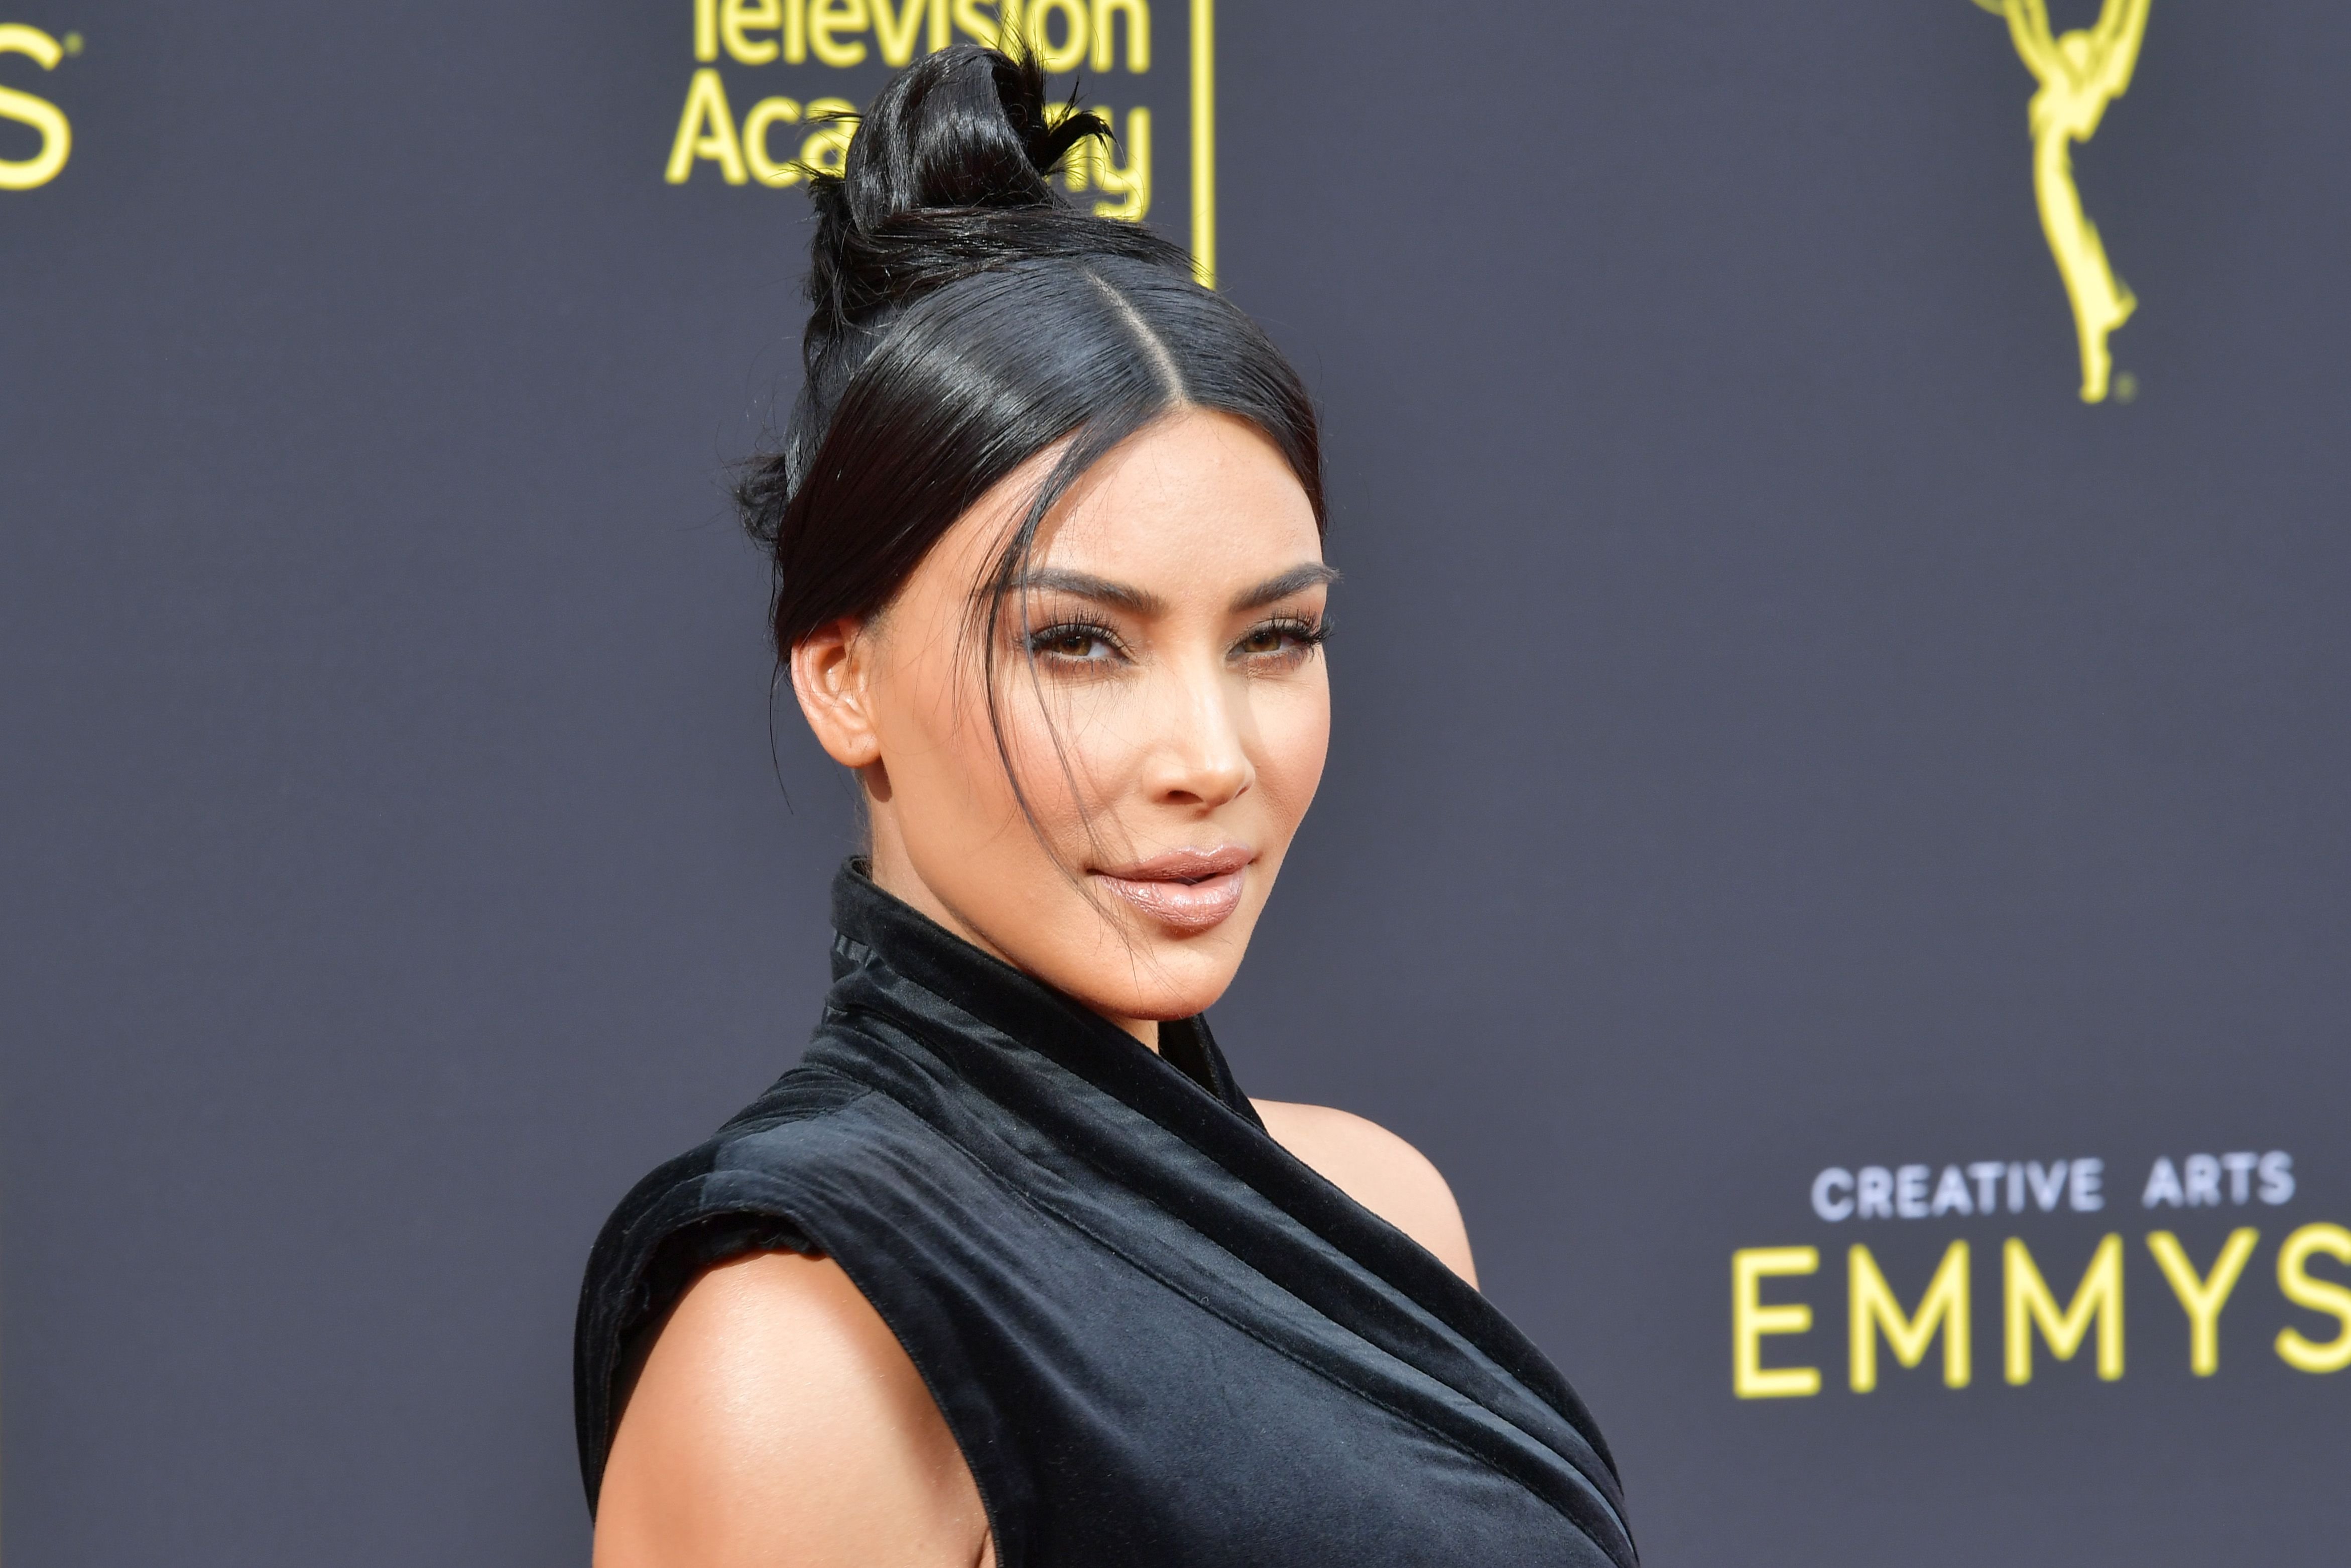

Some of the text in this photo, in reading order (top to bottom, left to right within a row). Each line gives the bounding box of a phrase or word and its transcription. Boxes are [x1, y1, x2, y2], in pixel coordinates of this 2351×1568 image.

[1811, 1151, 2296, 1222] CREATIVE ARTS
[1732, 1223, 2351, 1399] EMMYS
